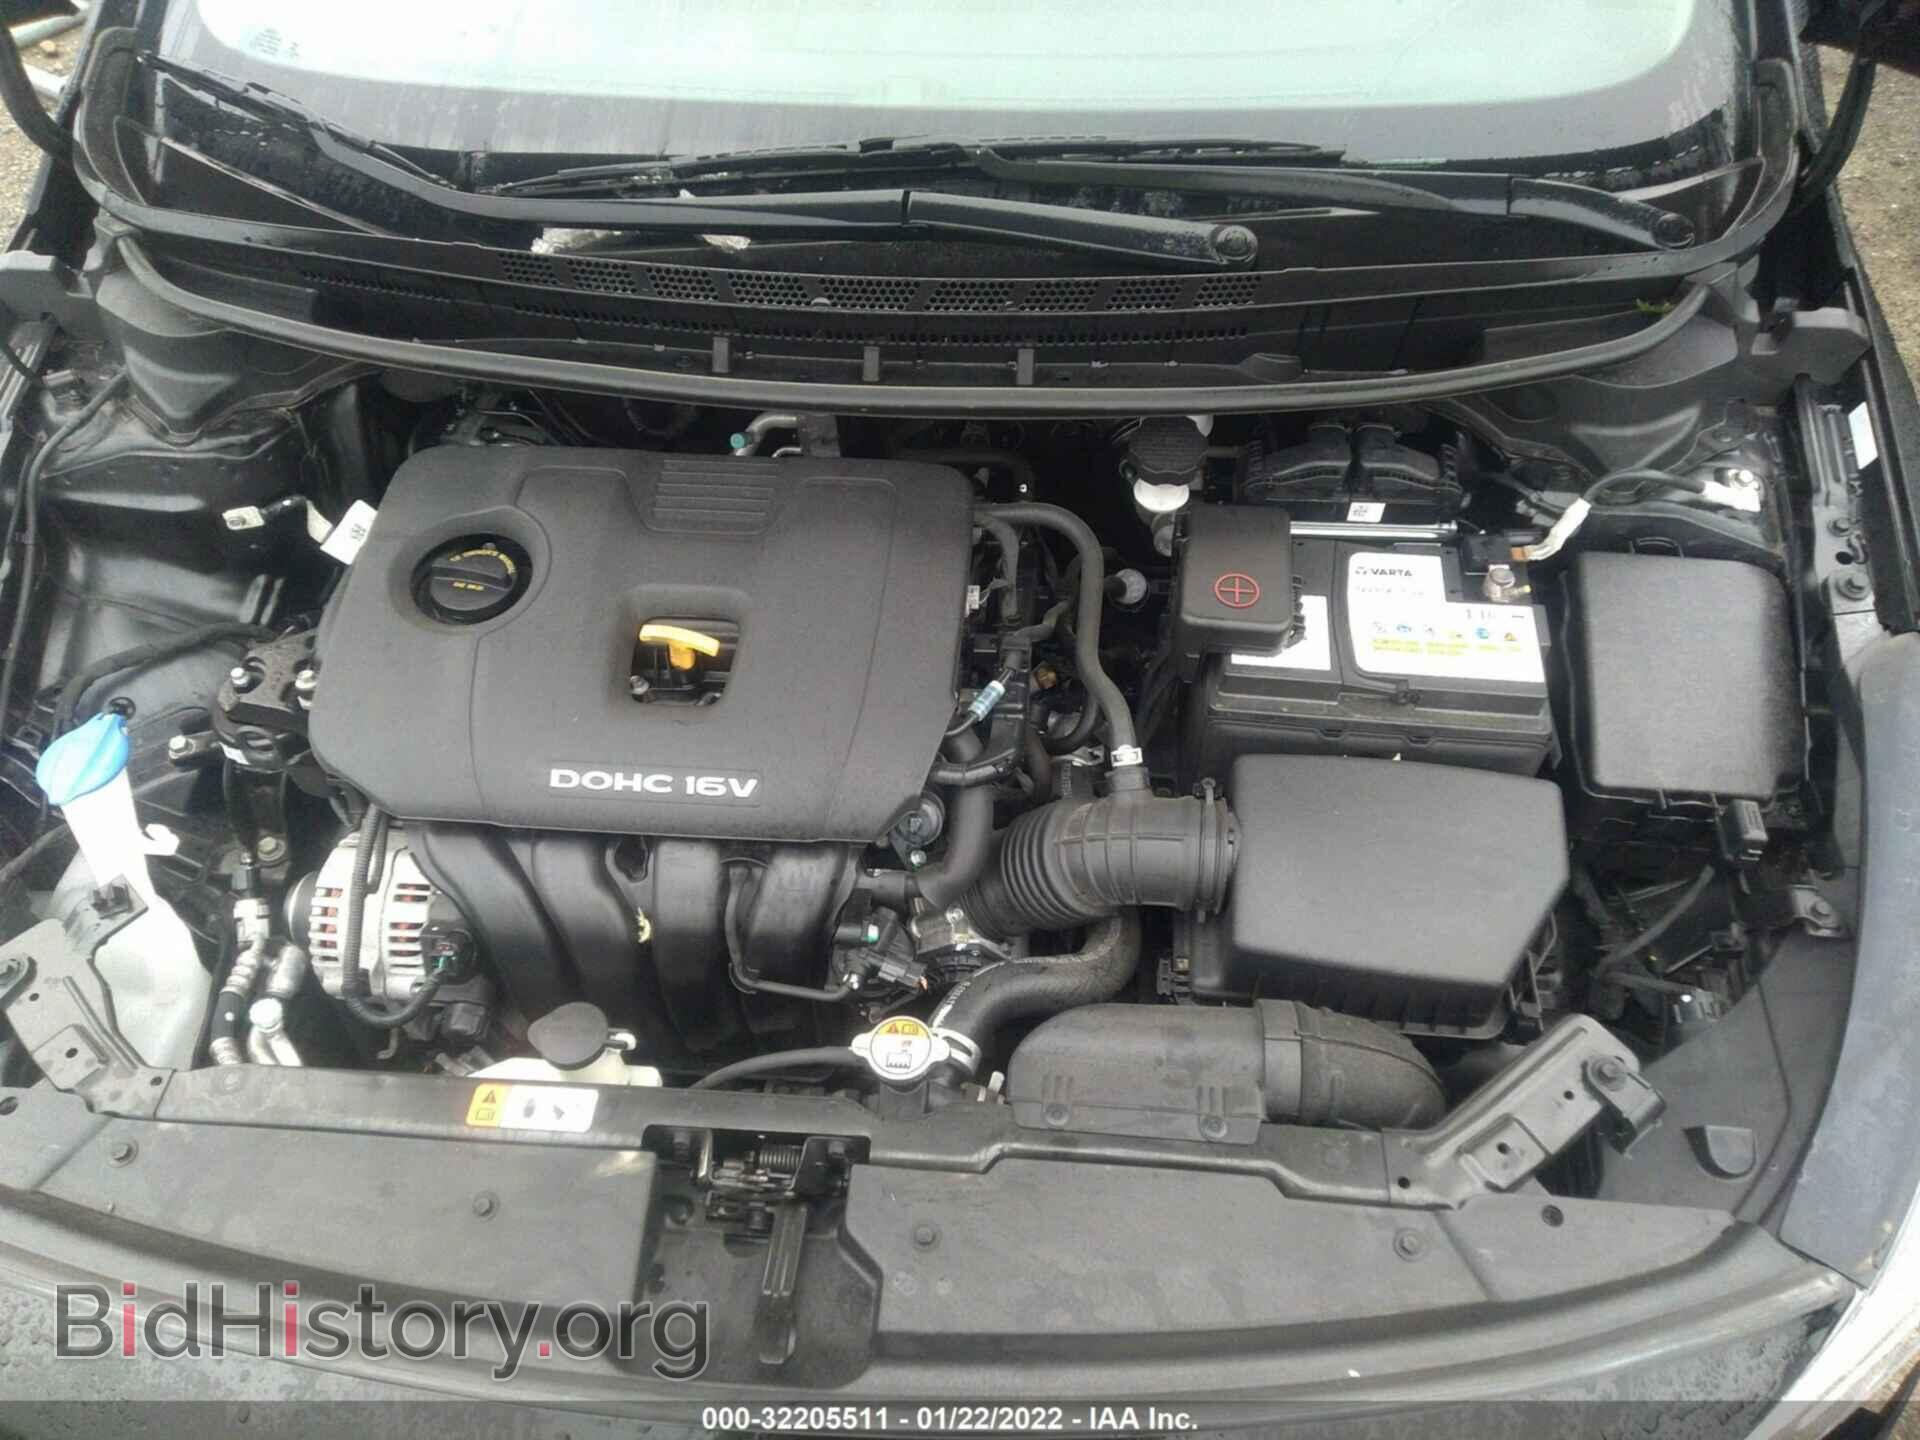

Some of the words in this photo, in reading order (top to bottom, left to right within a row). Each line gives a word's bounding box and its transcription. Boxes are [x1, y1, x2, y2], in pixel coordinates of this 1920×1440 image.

[1370, 568, 1413, 577] VARTA
[549, 768, 674, 793] DOHC
[685, 775, 760, 798] 16V
